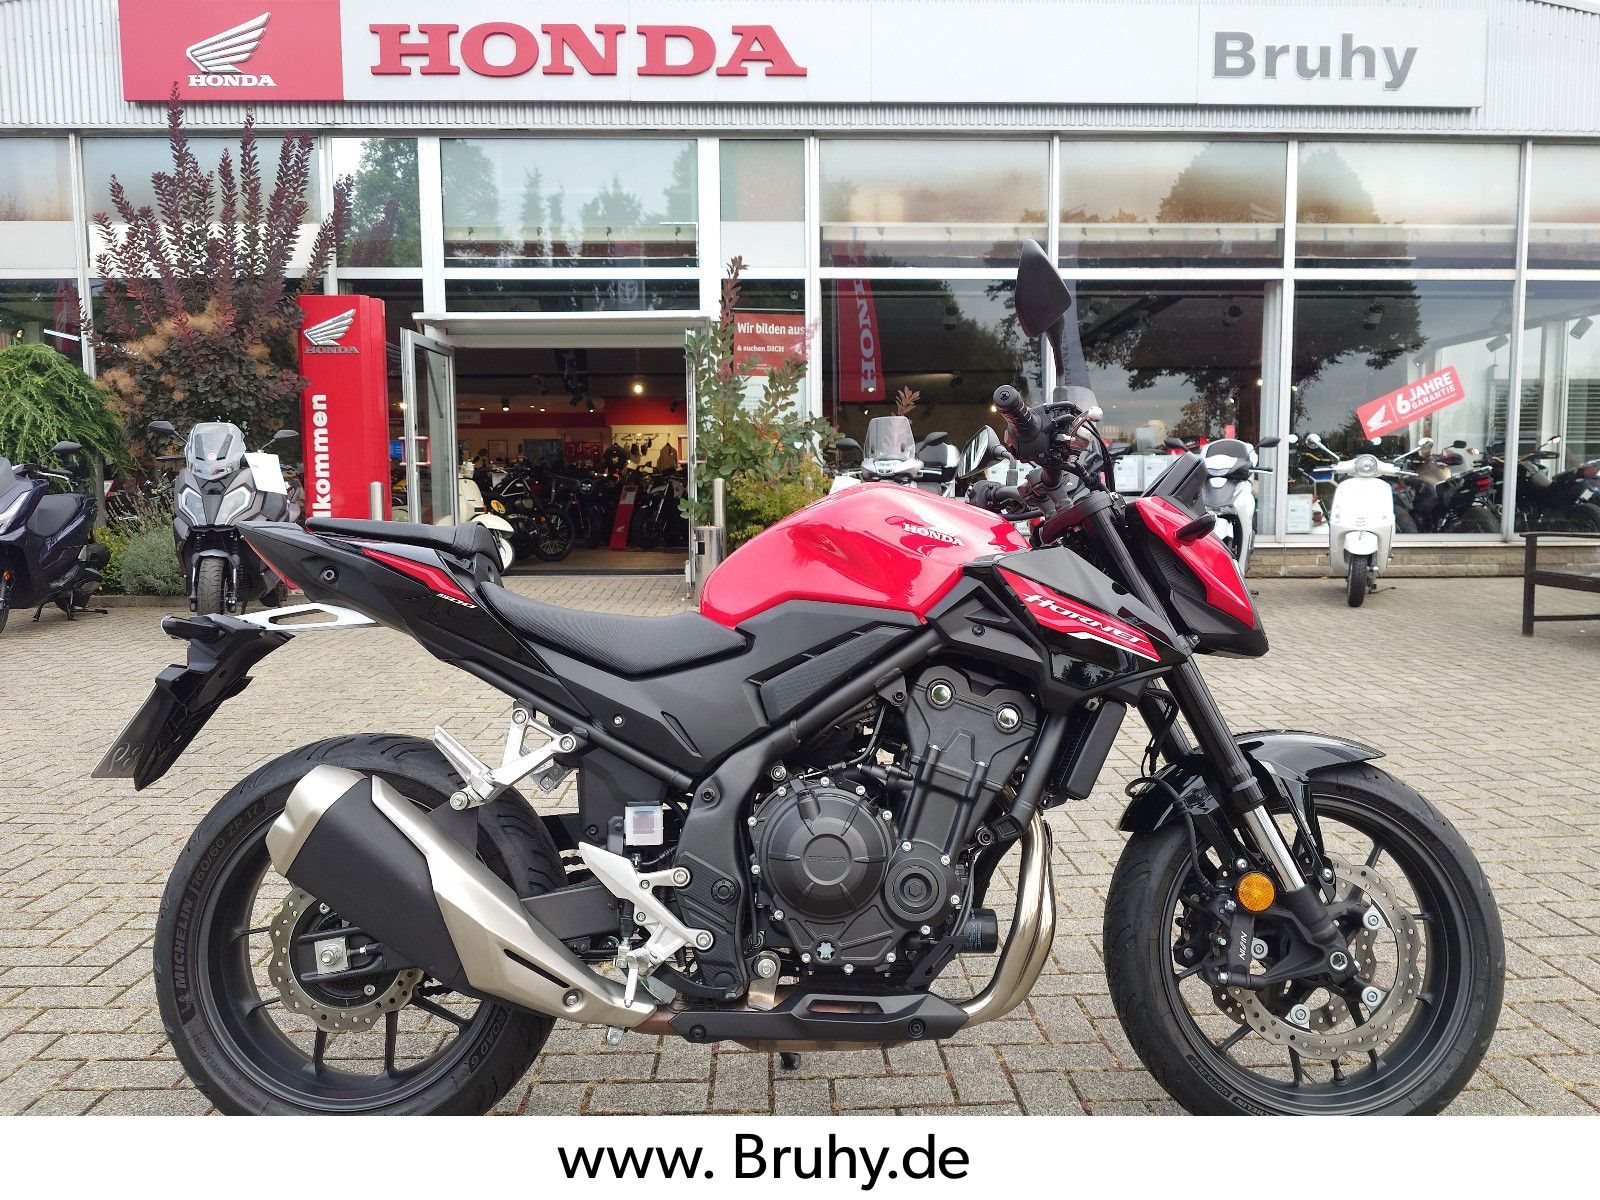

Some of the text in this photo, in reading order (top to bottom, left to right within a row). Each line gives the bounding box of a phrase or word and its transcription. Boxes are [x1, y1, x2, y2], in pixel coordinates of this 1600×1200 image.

[369, 22, 807, 77] HONDA
[1213, 31, 1418, 90] Bruhy
[187, 74, 277, 87] HONDA
[737, 322, 754, 334] Wir
[755, 323, 786, 335] bilden
[304, 346, 360, 354] HONDA
[766, 345, 785, 353] DICH
[1396, 393, 1411, 415] 6
[1409, 371, 1453, 402] JAHRE
[1411, 384, 1456, 409] GARANTIE
[312, 394, 332, 518] lkommen
[902, 522, 966, 547] HONDA
[174, 898, 193, 989] MICHELIN
